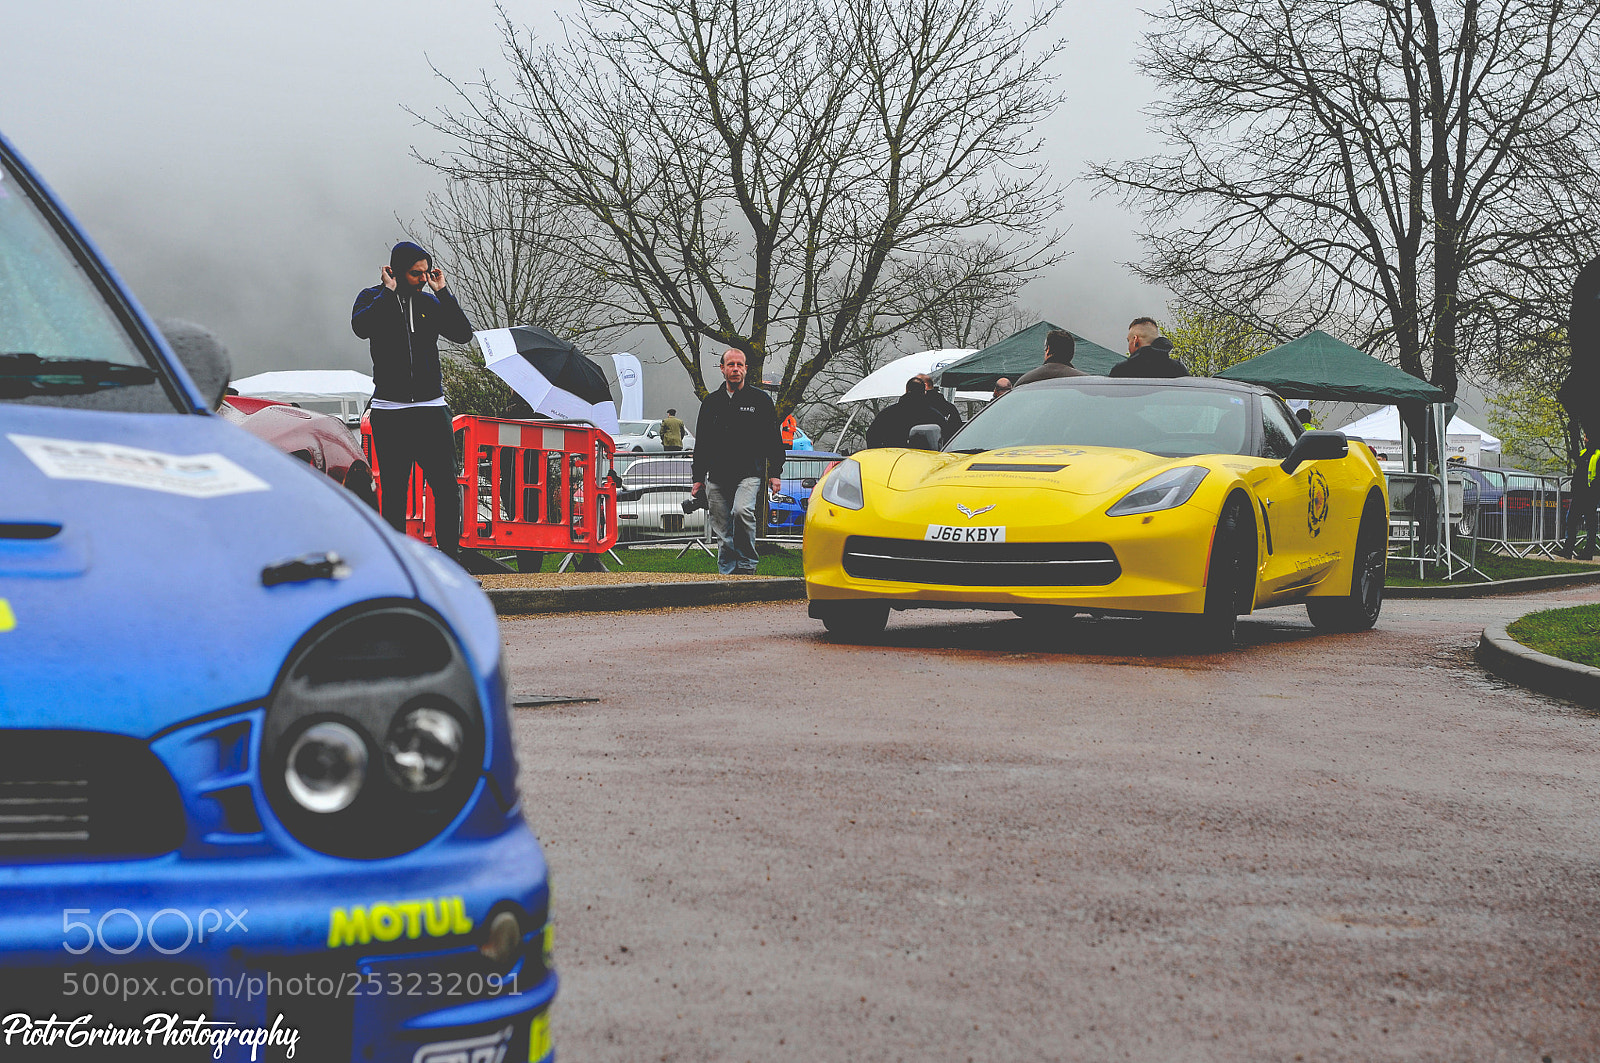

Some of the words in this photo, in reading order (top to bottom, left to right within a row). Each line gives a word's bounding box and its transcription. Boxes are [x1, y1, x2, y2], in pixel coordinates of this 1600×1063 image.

[931, 526, 963, 541] J66
[965, 528, 999, 541] KBY
[327, 896, 473, 948] MOTUL
